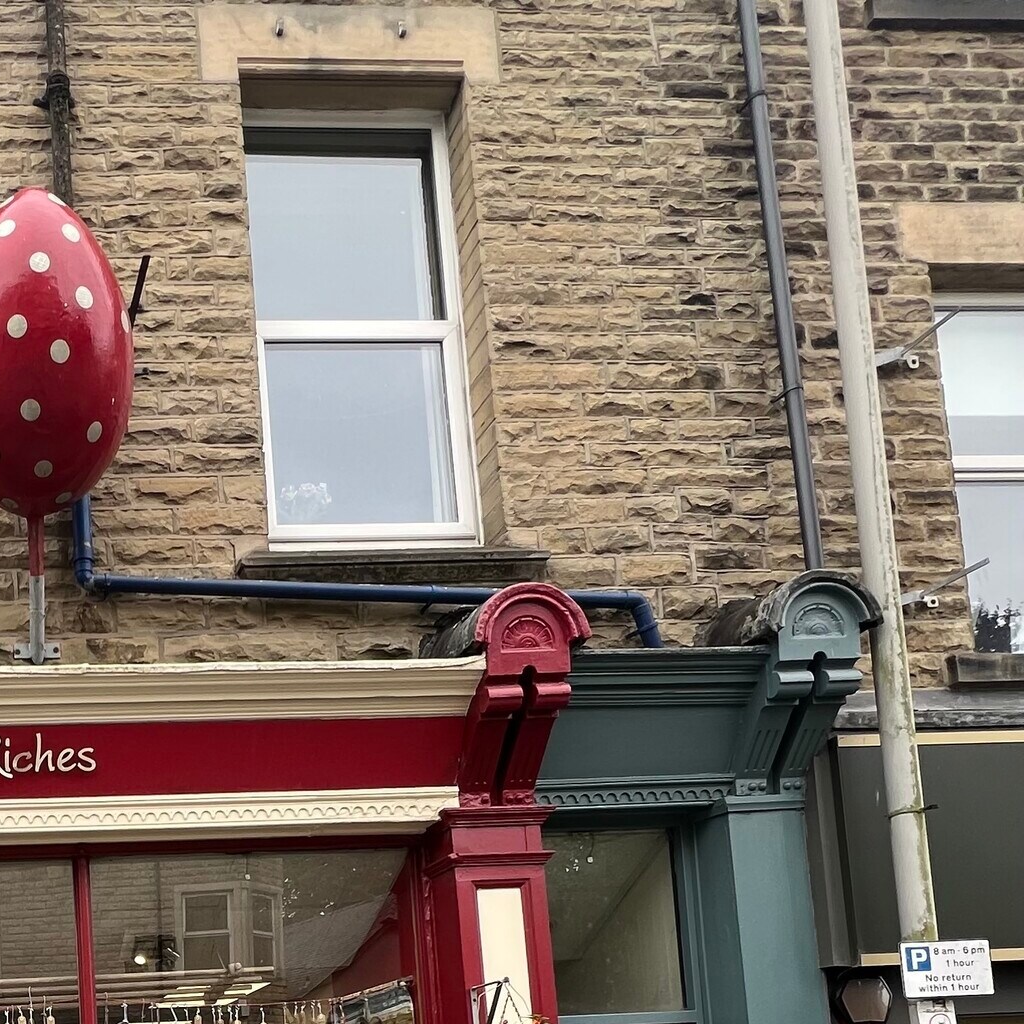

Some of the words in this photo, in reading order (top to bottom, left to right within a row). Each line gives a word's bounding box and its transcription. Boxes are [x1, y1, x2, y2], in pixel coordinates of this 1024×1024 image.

[971, 947, 985, 955] pm
[919, 984, 948, 992] within
[958, 983, 980, 991] hour
